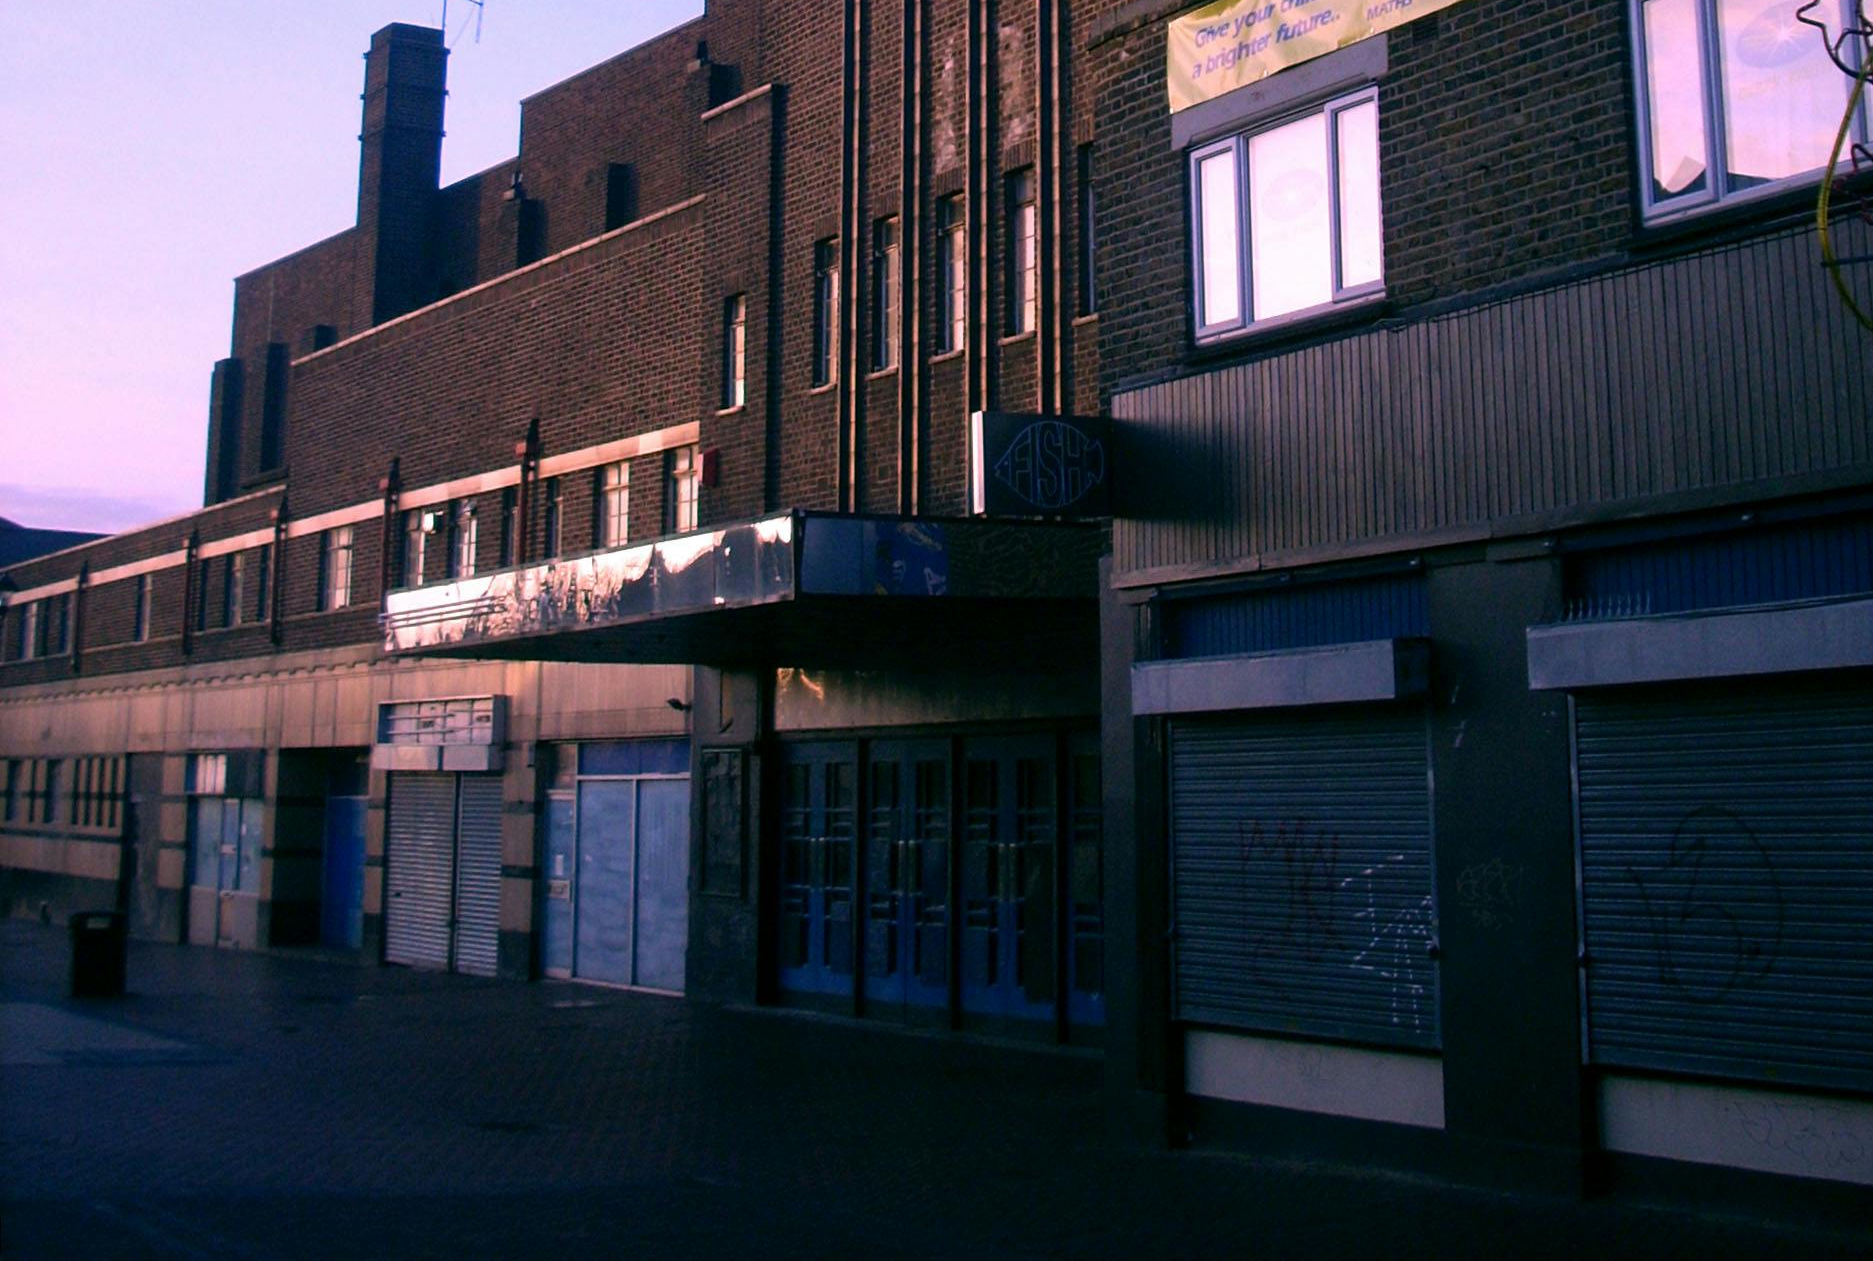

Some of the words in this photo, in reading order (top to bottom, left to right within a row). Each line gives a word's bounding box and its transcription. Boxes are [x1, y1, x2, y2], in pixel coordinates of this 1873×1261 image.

[1194, 21, 1230, 48] Give
[1231, 3, 1276, 39] your
[1192, 63, 1203, 80] a
[1205, 32, 1272, 75] brighter
[1008, 420, 1087, 507] FISH
